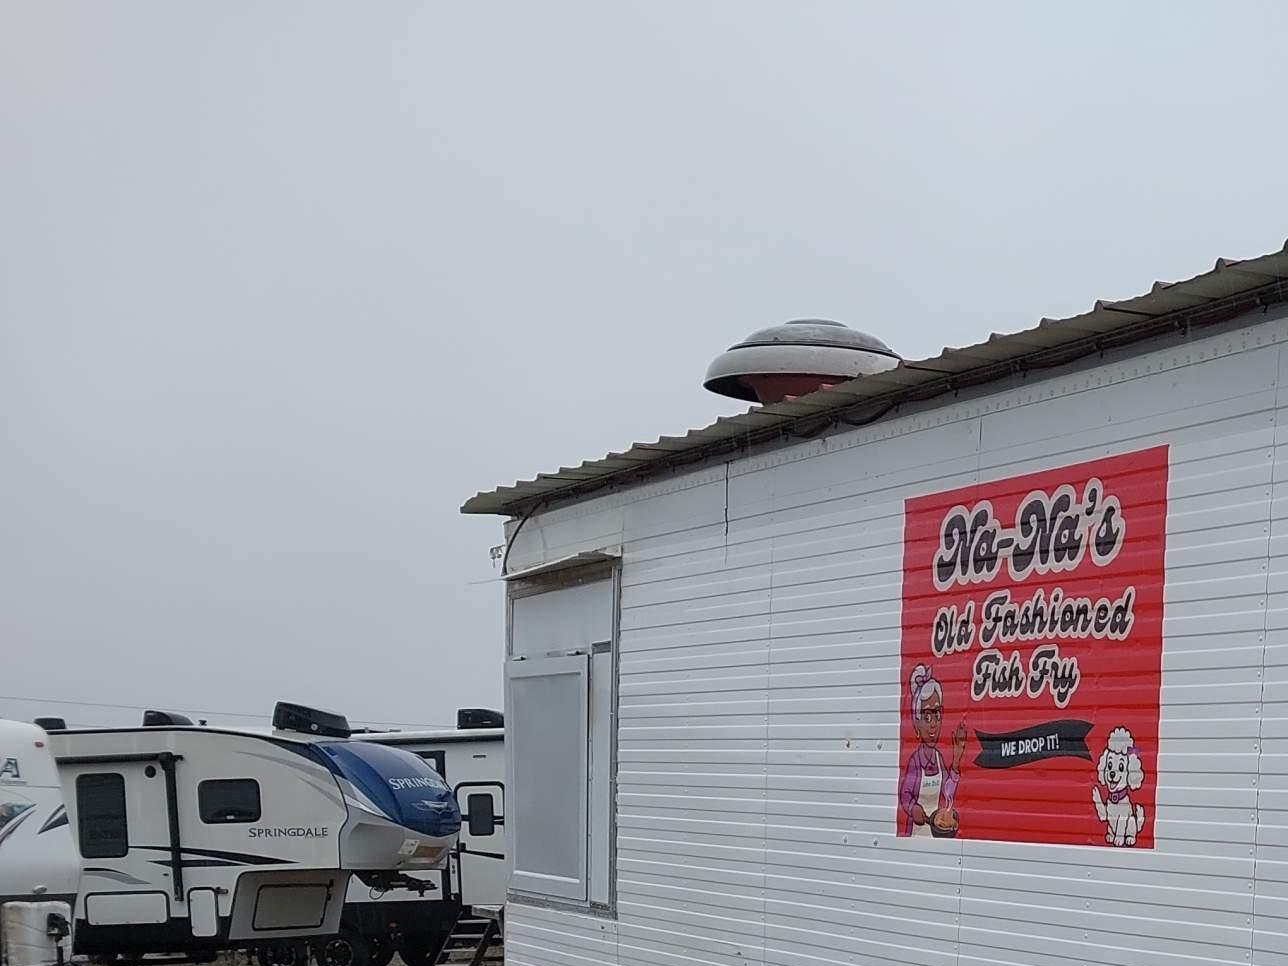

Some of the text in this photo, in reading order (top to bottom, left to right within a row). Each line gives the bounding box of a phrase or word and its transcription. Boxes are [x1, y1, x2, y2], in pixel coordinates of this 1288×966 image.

[935, 482, 1124, 587] Na-Na's
[932, 587, 1135, 656] Old Fashioned
[973, 647, 1078, 705] Fish Fry
[1001, 733, 1060, 757] WE DROP IT!
[248, 827, 329, 838] SPRINGDALE
